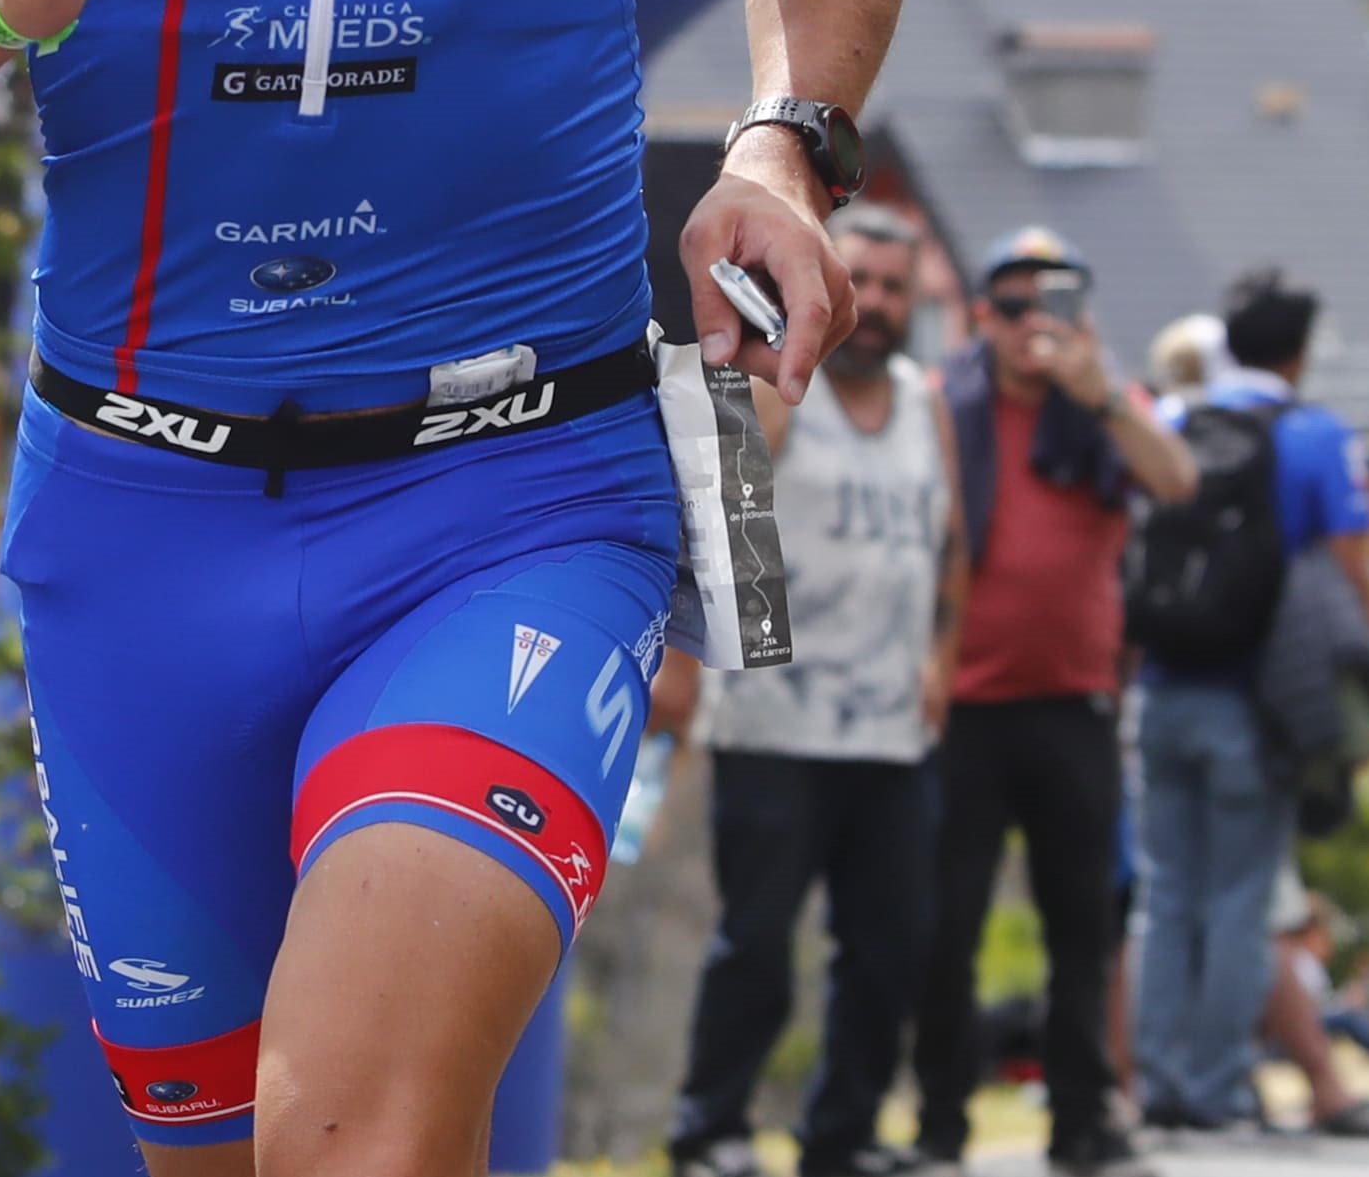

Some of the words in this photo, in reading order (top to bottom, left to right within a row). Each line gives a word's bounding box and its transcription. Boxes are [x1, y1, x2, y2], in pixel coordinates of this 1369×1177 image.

[215, 214, 377, 243] GARMIN
[96, 392, 231, 453] 2XU
[413, 381, 555, 446] 2XU
[492, 792, 541, 827] GU
[116, 986, 206, 1009] SUAREZ
[146, 1098, 219, 1114] SUBARU
